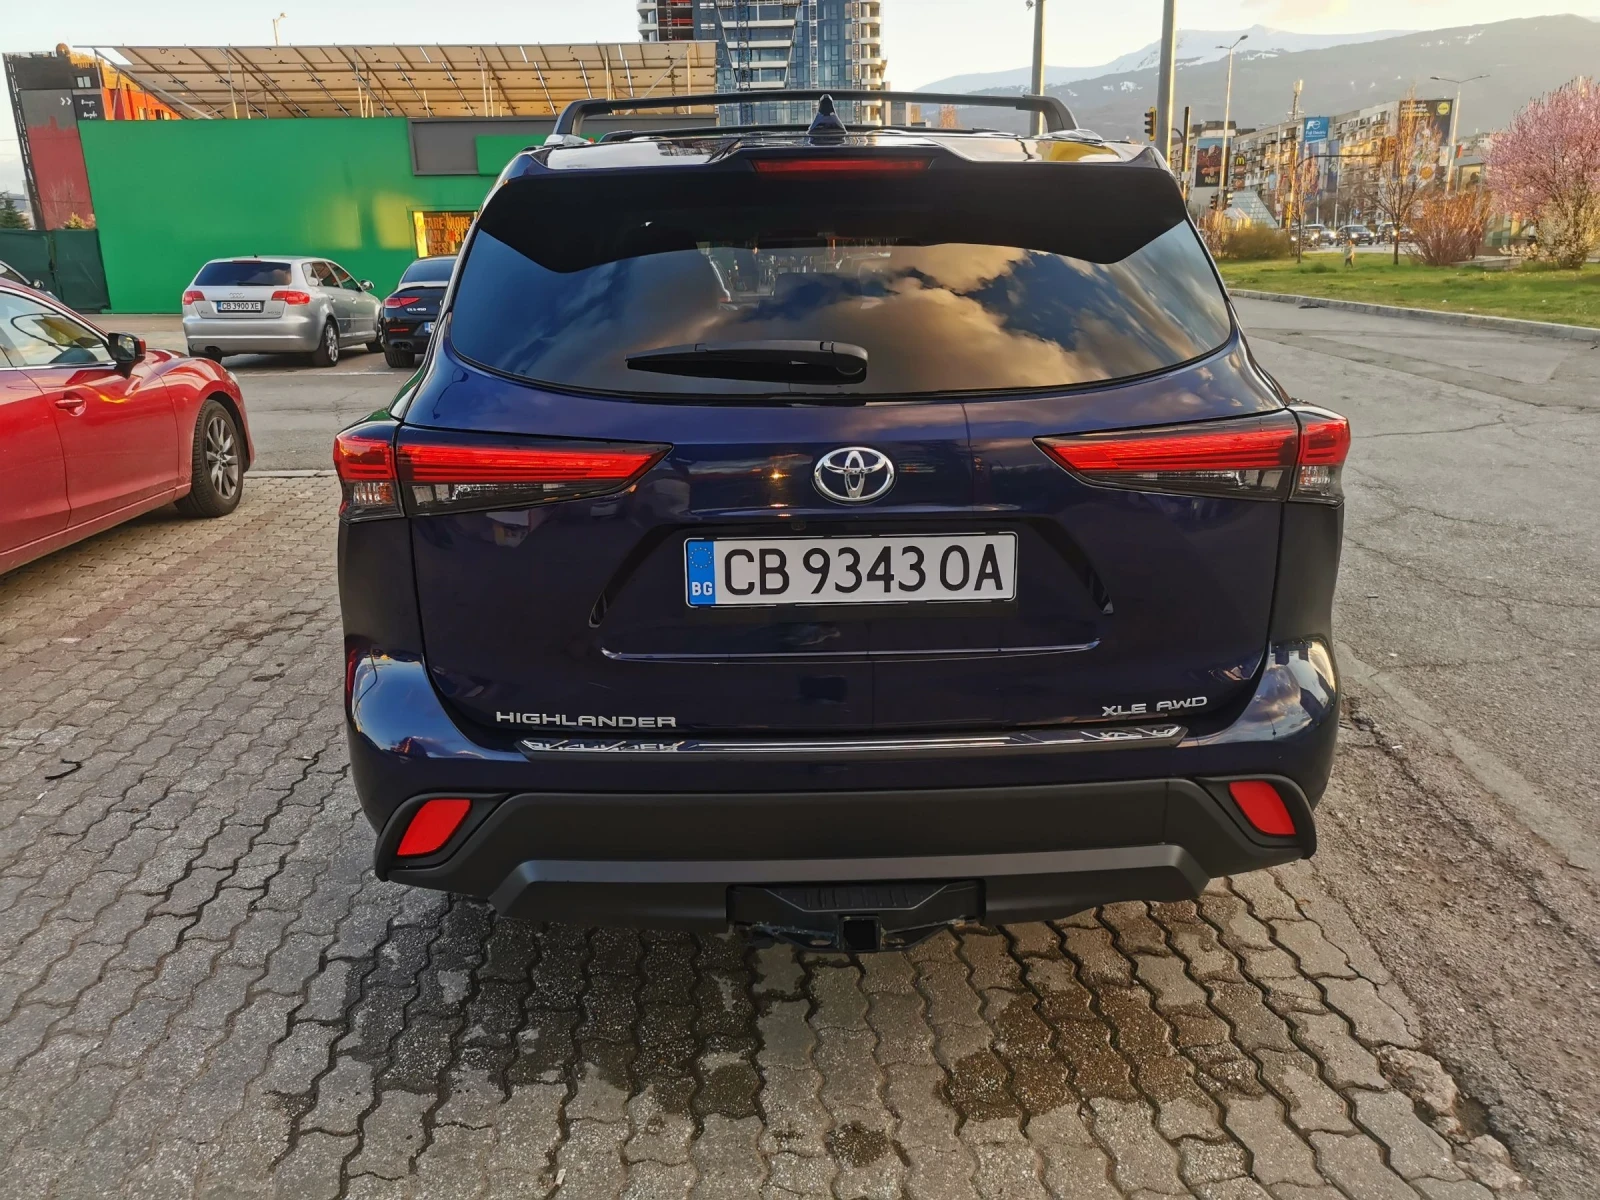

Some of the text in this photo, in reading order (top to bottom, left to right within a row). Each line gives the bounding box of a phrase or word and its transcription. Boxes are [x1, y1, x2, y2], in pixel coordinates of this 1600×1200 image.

[221, 302, 260, 310] CB 3900 XE
[724, 543, 1004, 596] CB 9343 OA
[691, 581, 713, 596] BG
[1101, 696, 1208, 717] XLE AWD
[495, 711, 677, 728] HIGHLANDER
